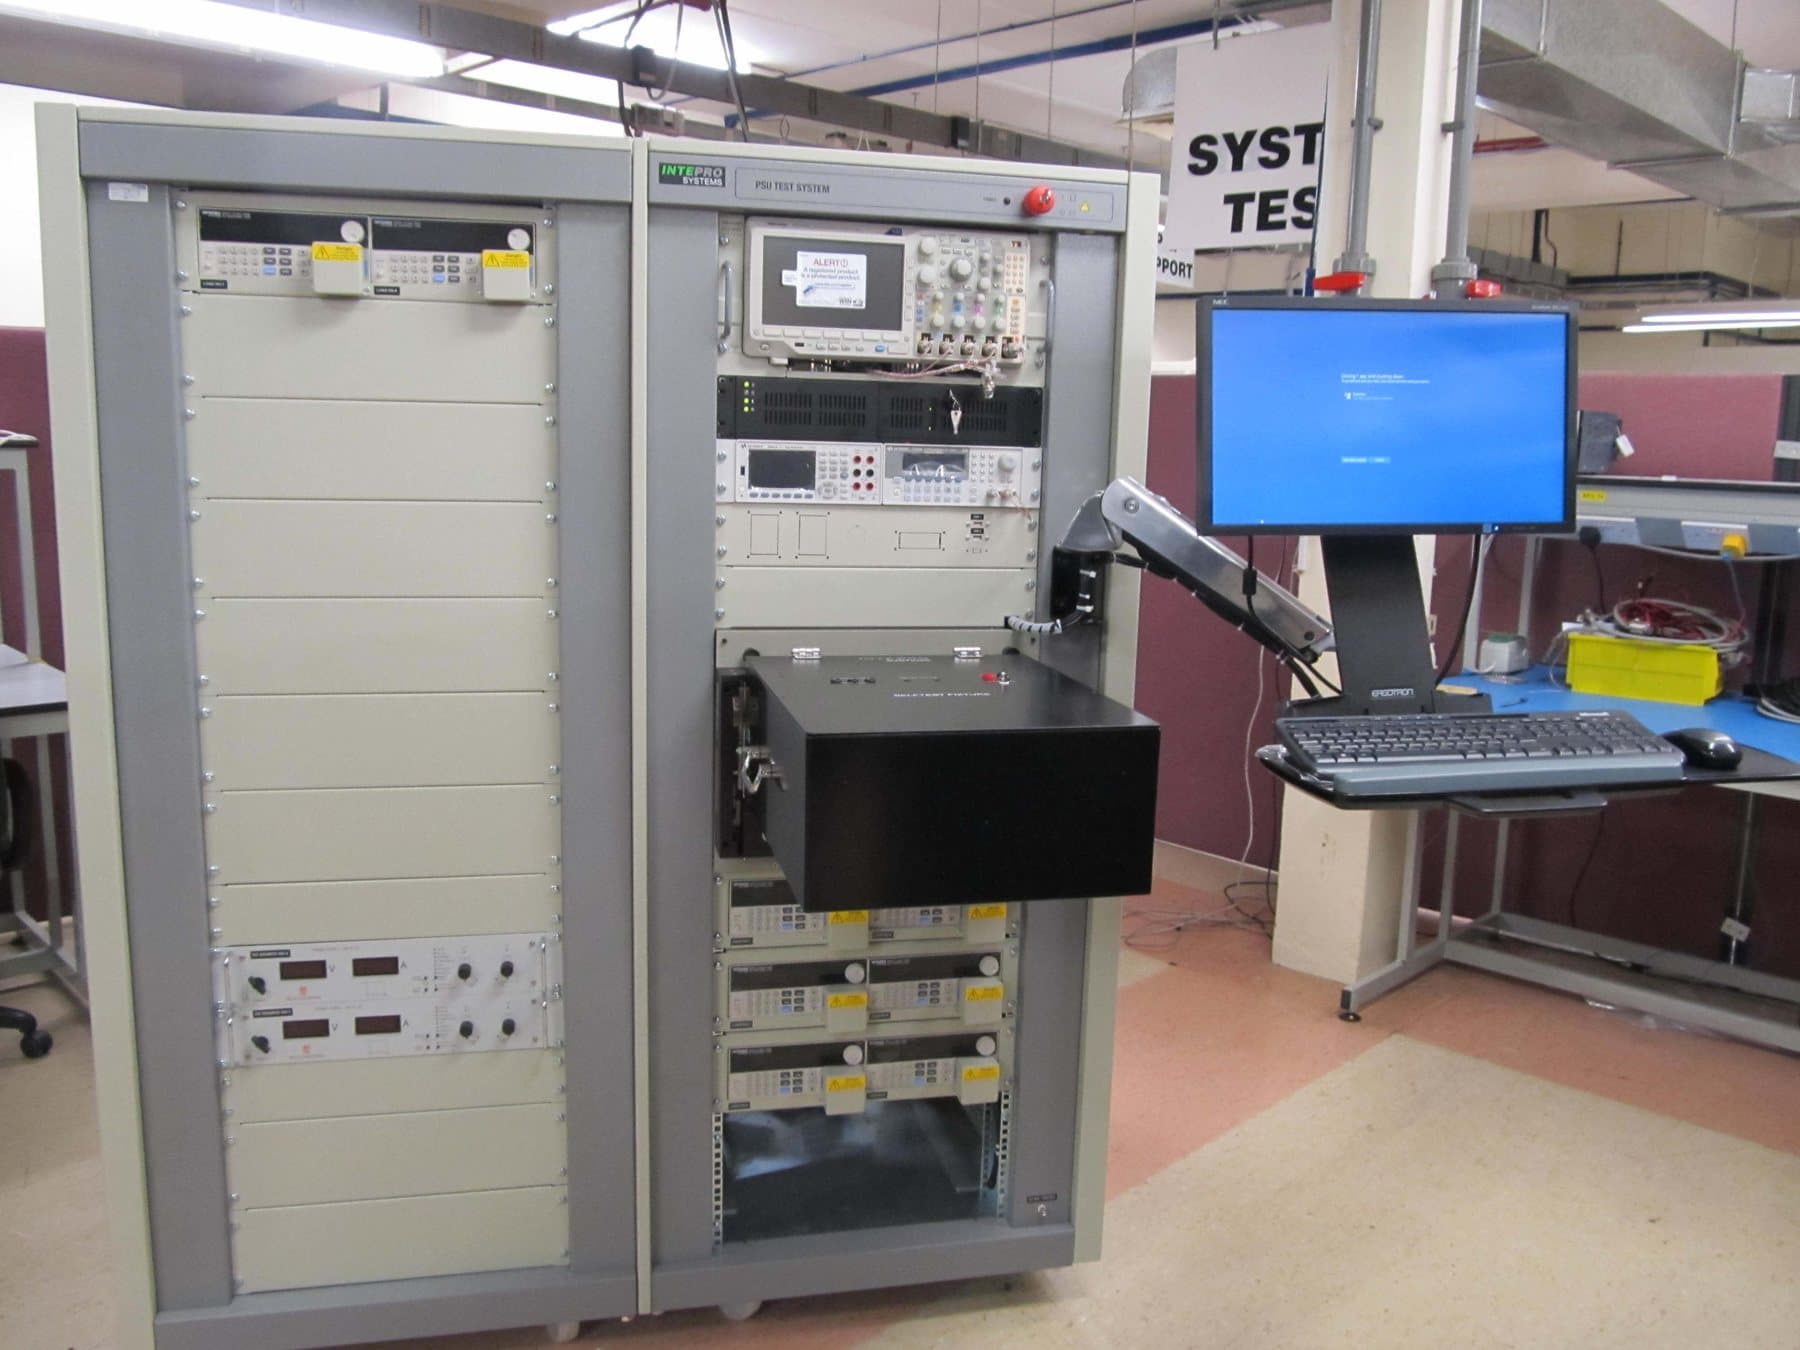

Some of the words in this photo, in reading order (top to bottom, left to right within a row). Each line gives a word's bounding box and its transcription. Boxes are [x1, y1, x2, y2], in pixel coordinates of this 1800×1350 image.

[1187, 122, 1325, 176] SYST
[661, 164, 723, 177] INTEPRO
[682, 176, 723, 186] SYSTEMS
[755, 180, 772, 190] PSU
[775, 181, 793, 192] TEST
[798, 183, 830, 194] SYSTEM
[1223, 186, 1317, 233] TES
